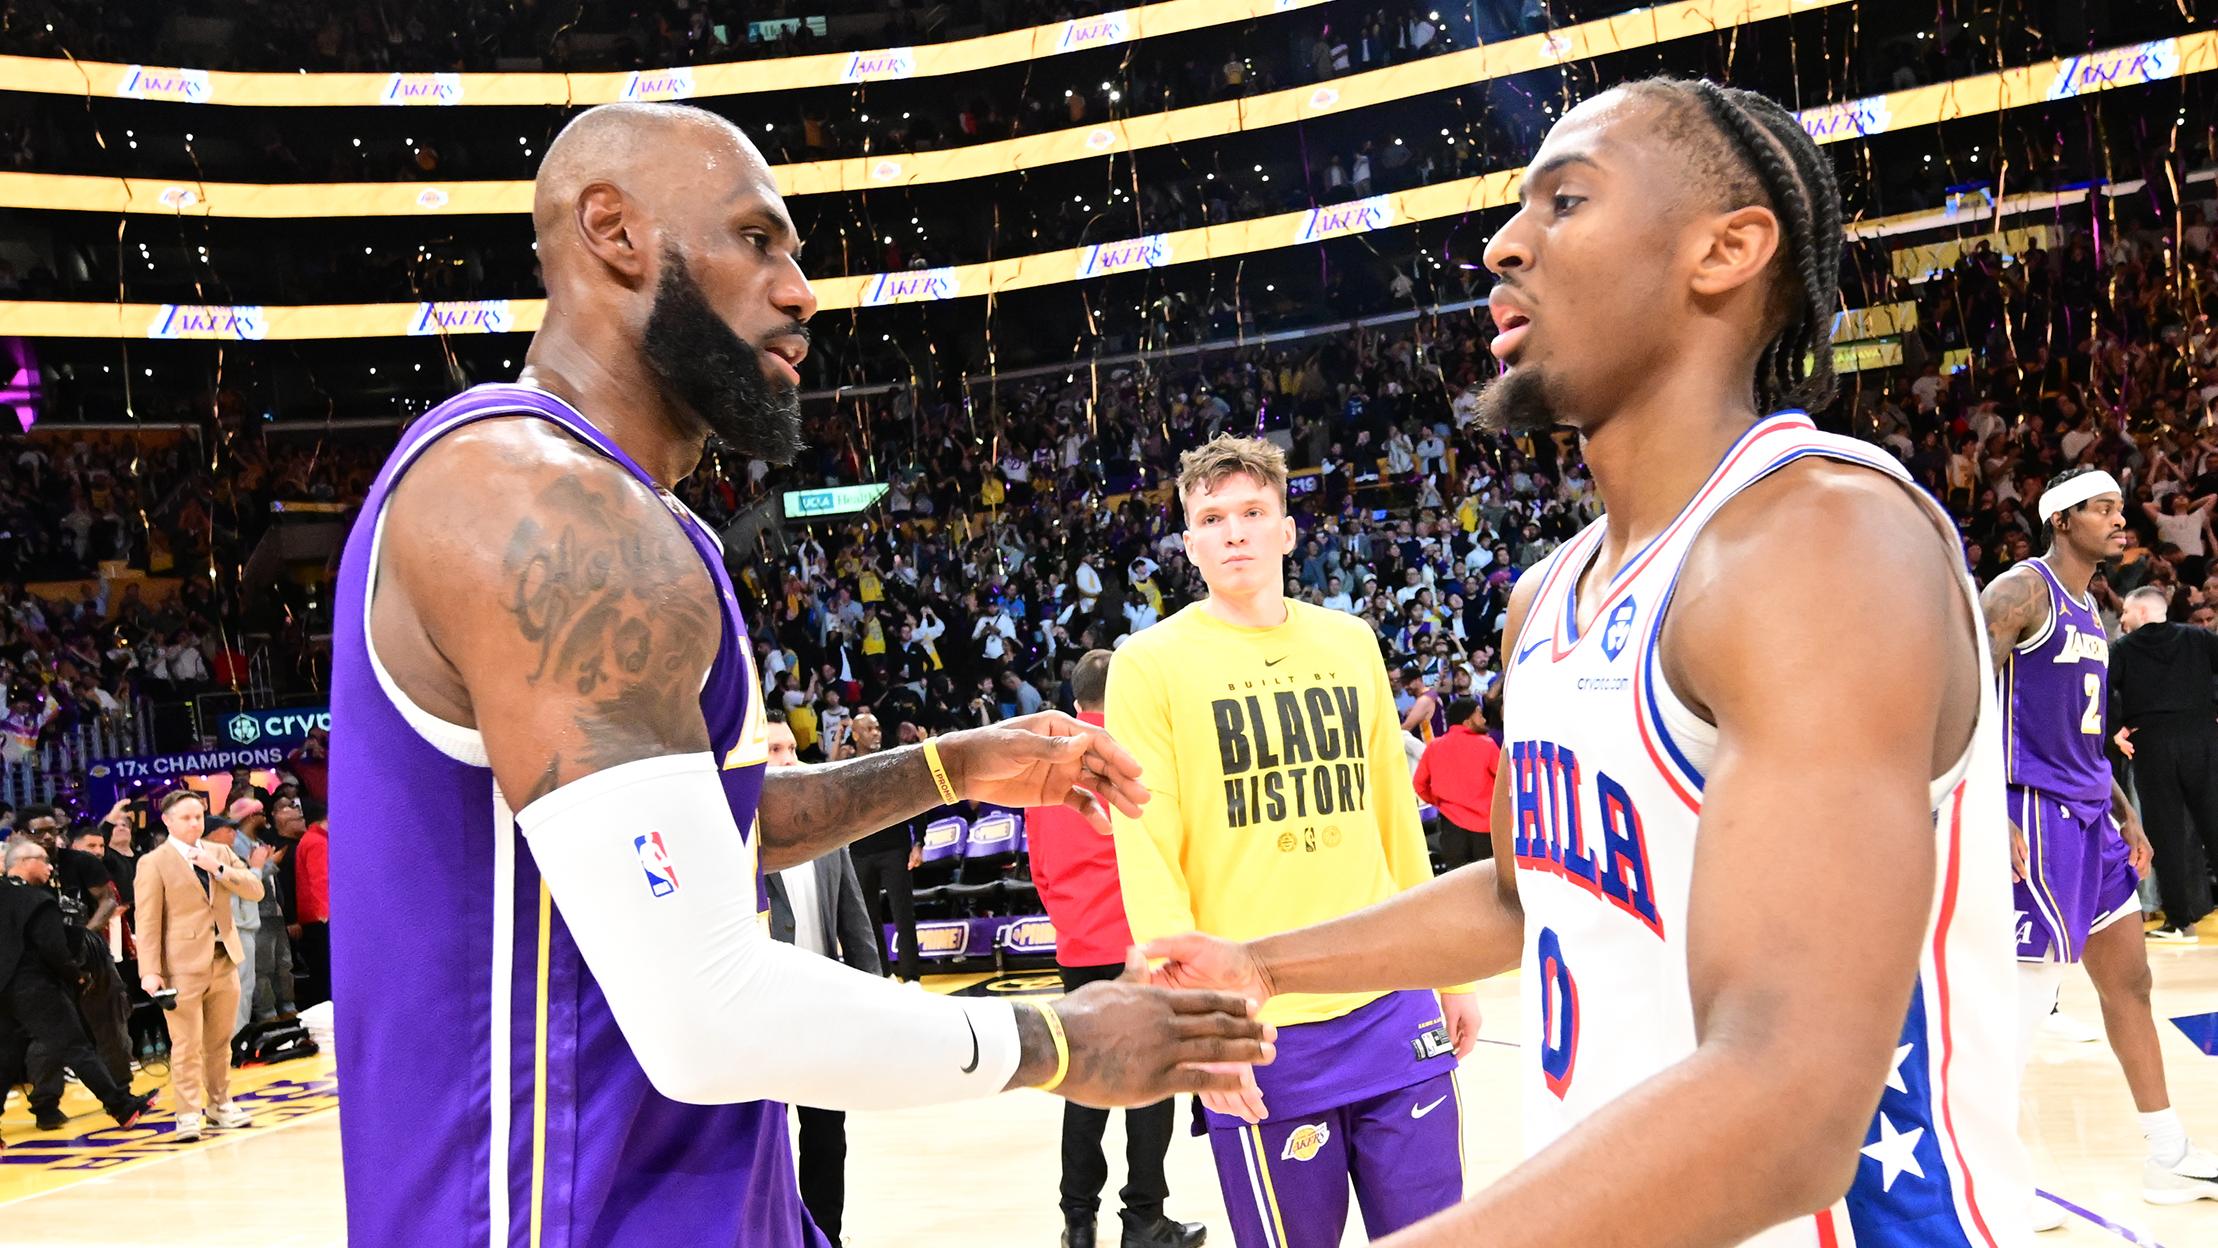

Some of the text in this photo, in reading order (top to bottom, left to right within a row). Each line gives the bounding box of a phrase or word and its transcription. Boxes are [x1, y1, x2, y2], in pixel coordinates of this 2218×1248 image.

[873, 272, 949, 302] LAKERS
[1228, 672, 1336, 691] BUILT BY
[2081, 673, 2102, 734] 2
[1211, 686, 1365, 775] BLACK
[116, 748, 283, 777] 17x CHAMPIONS
[1224, 763, 1365, 828] HISTORY
[1508, 740, 1665, 942] HILA
[1538, 926, 1580, 1101] 0
